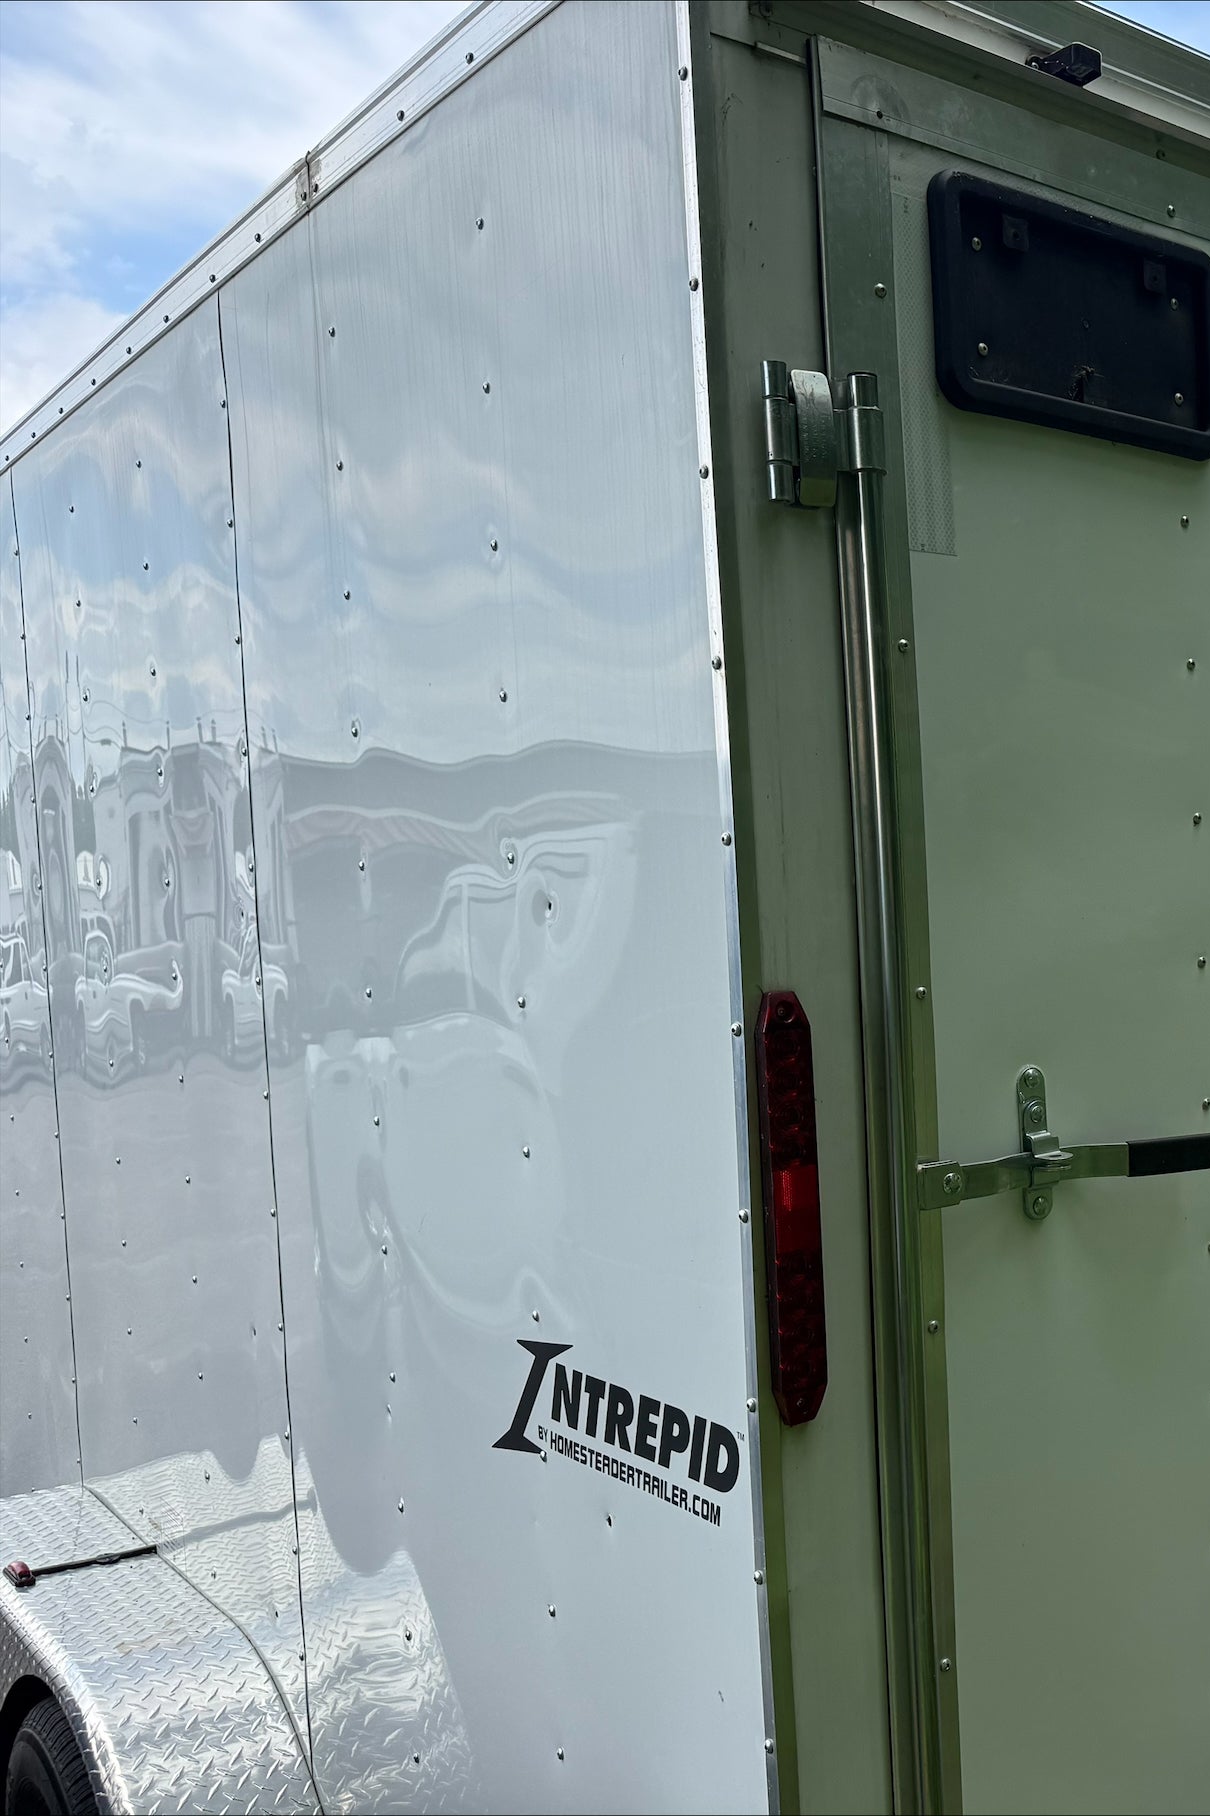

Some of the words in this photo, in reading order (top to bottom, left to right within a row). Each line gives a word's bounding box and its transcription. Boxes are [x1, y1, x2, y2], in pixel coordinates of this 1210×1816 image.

[491, 1339, 740, 1493] INTREPID
[538, 1425, 548, 1442] BY
[550, 1432, 721, 1527] HOMESTEADERTRAILER.COM
